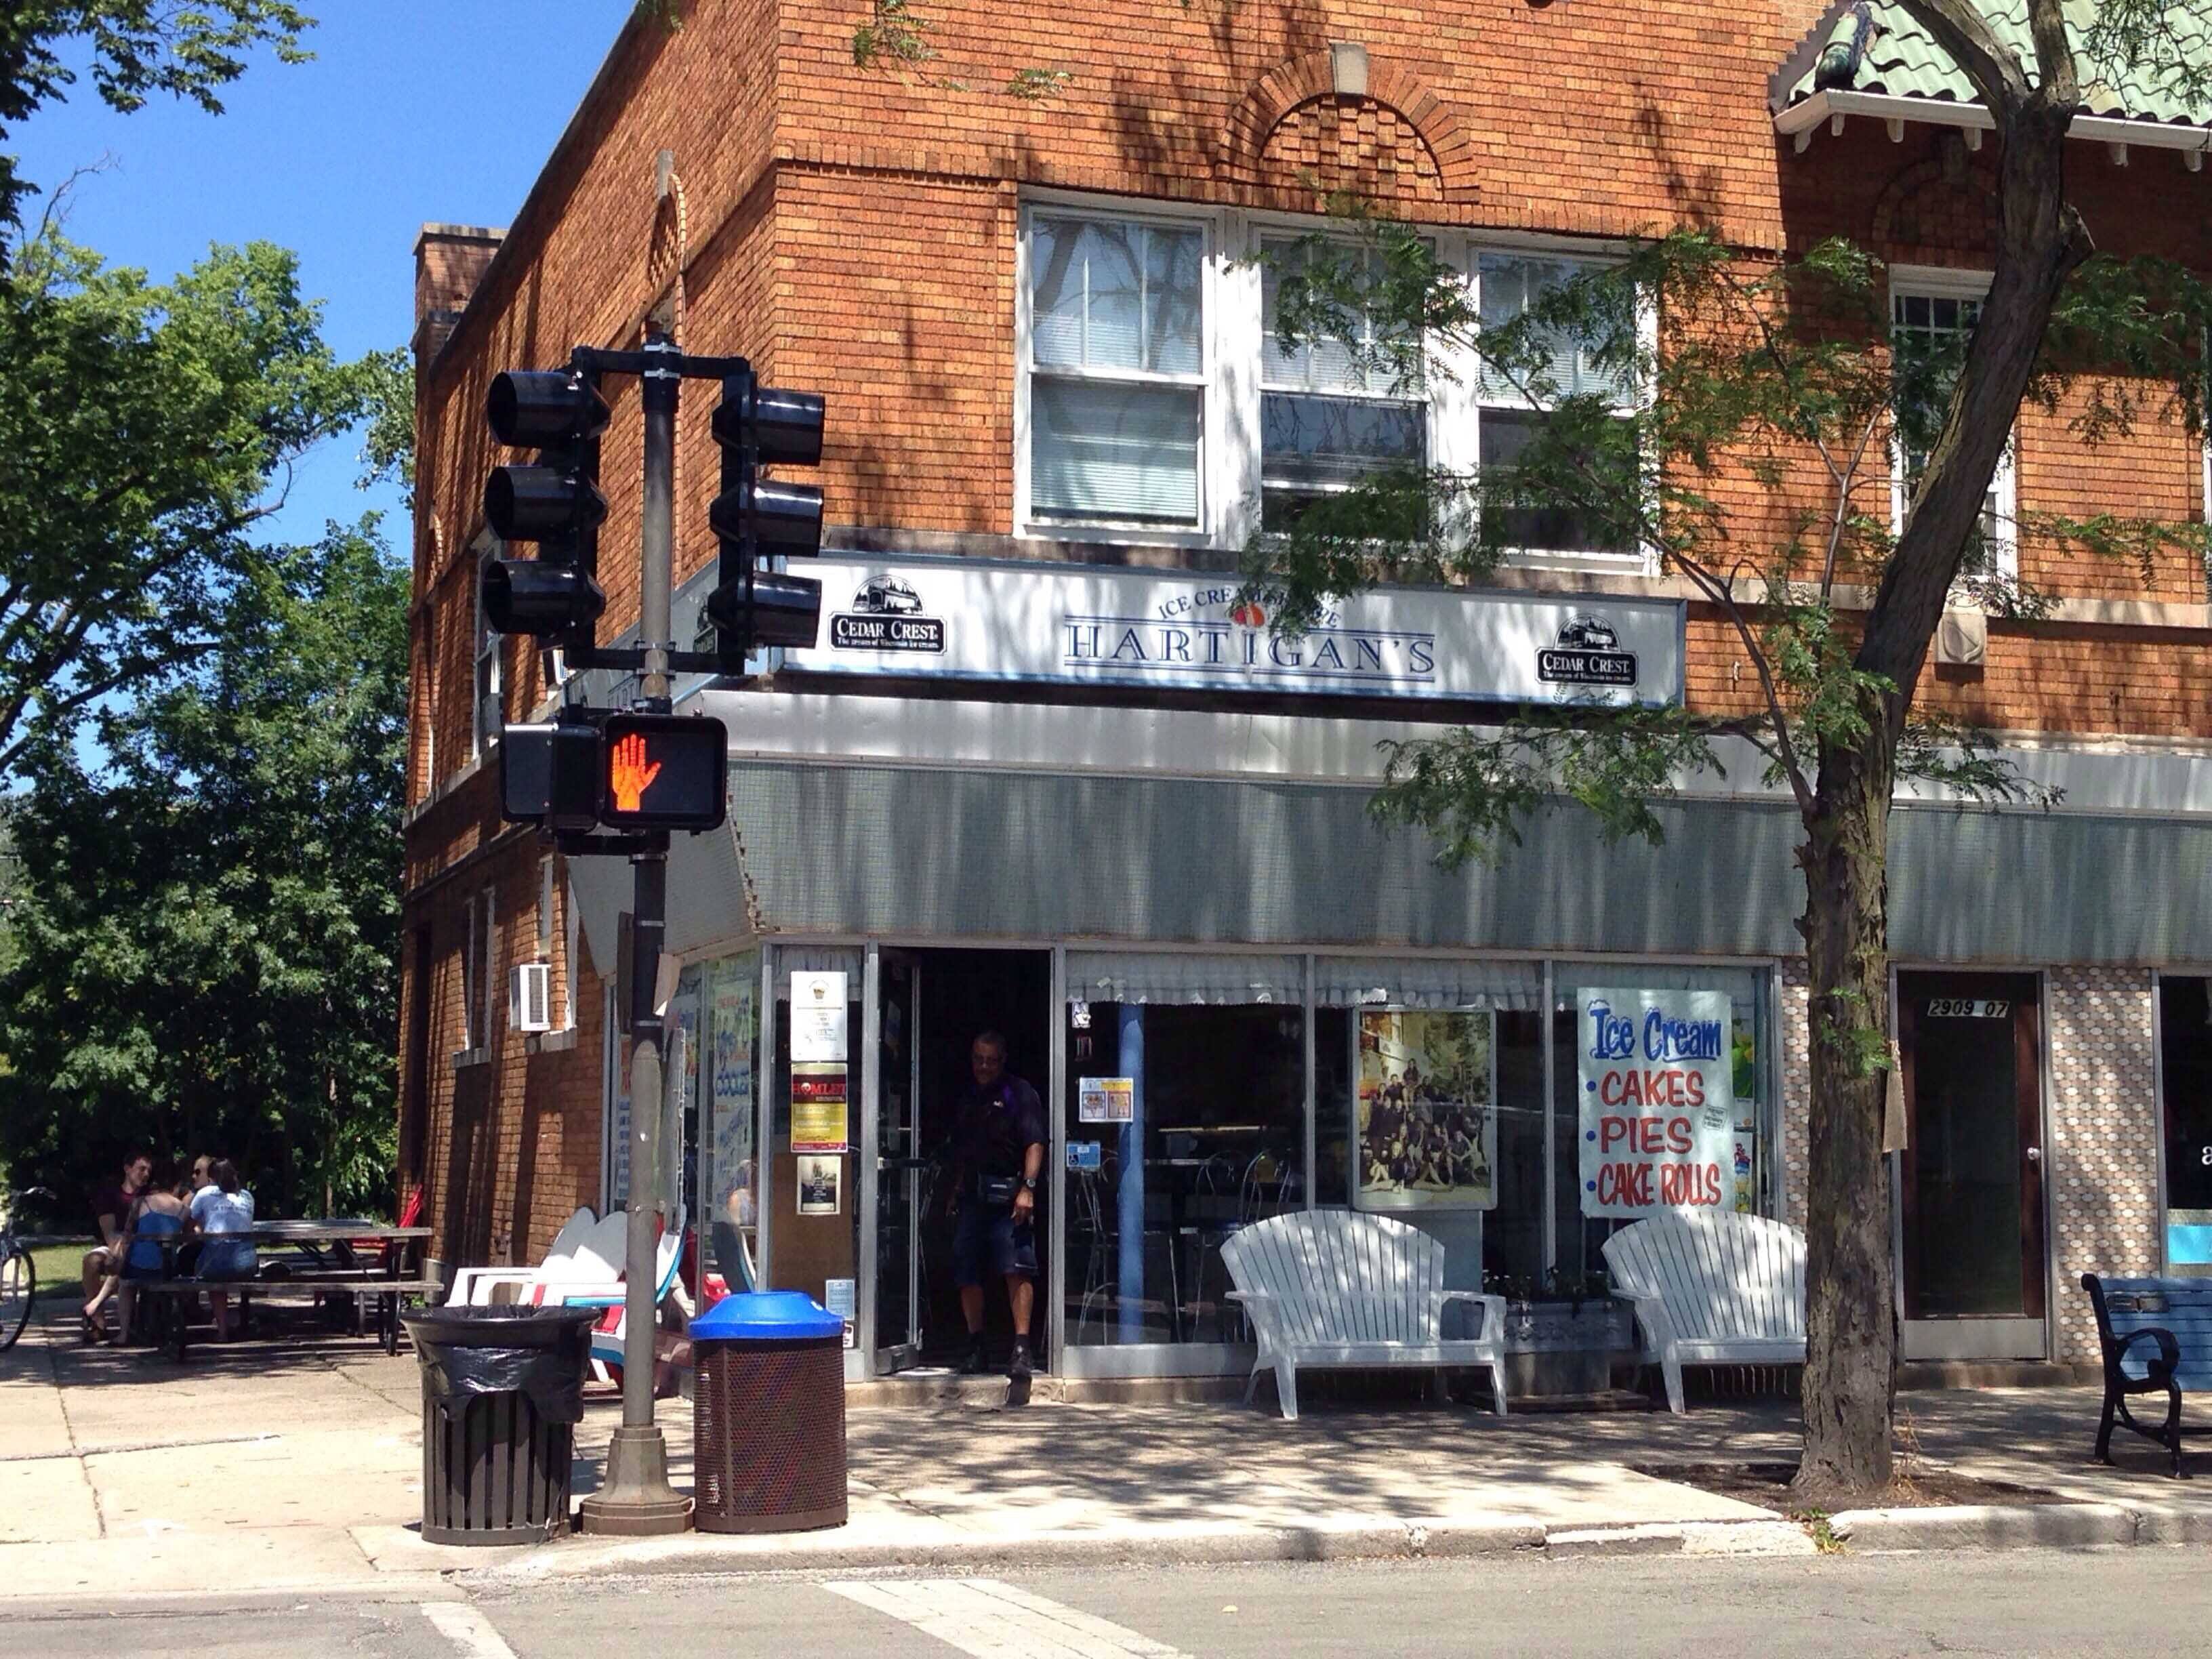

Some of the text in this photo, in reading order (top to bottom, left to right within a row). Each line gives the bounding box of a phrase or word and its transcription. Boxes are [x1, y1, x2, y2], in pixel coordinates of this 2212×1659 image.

[1158, 596, 1191, 619] ICE
[836, 618, 937, 640] CEDAR CREST
[1064, 623, 1435, 674] HARTIGAN'S
[1542, 653, 1631, 674] CEDAR CREST
[1930, 1000, 1975, 1016] 2909
[1589, 1003, 1722, 1061] Ice Cream
[1600, 1069, 1706, 1107] CAKES
[1599, 1116, 1694, 1153] PIES
[1597, 1162, 1722, 1208] CAKE ROLLS
